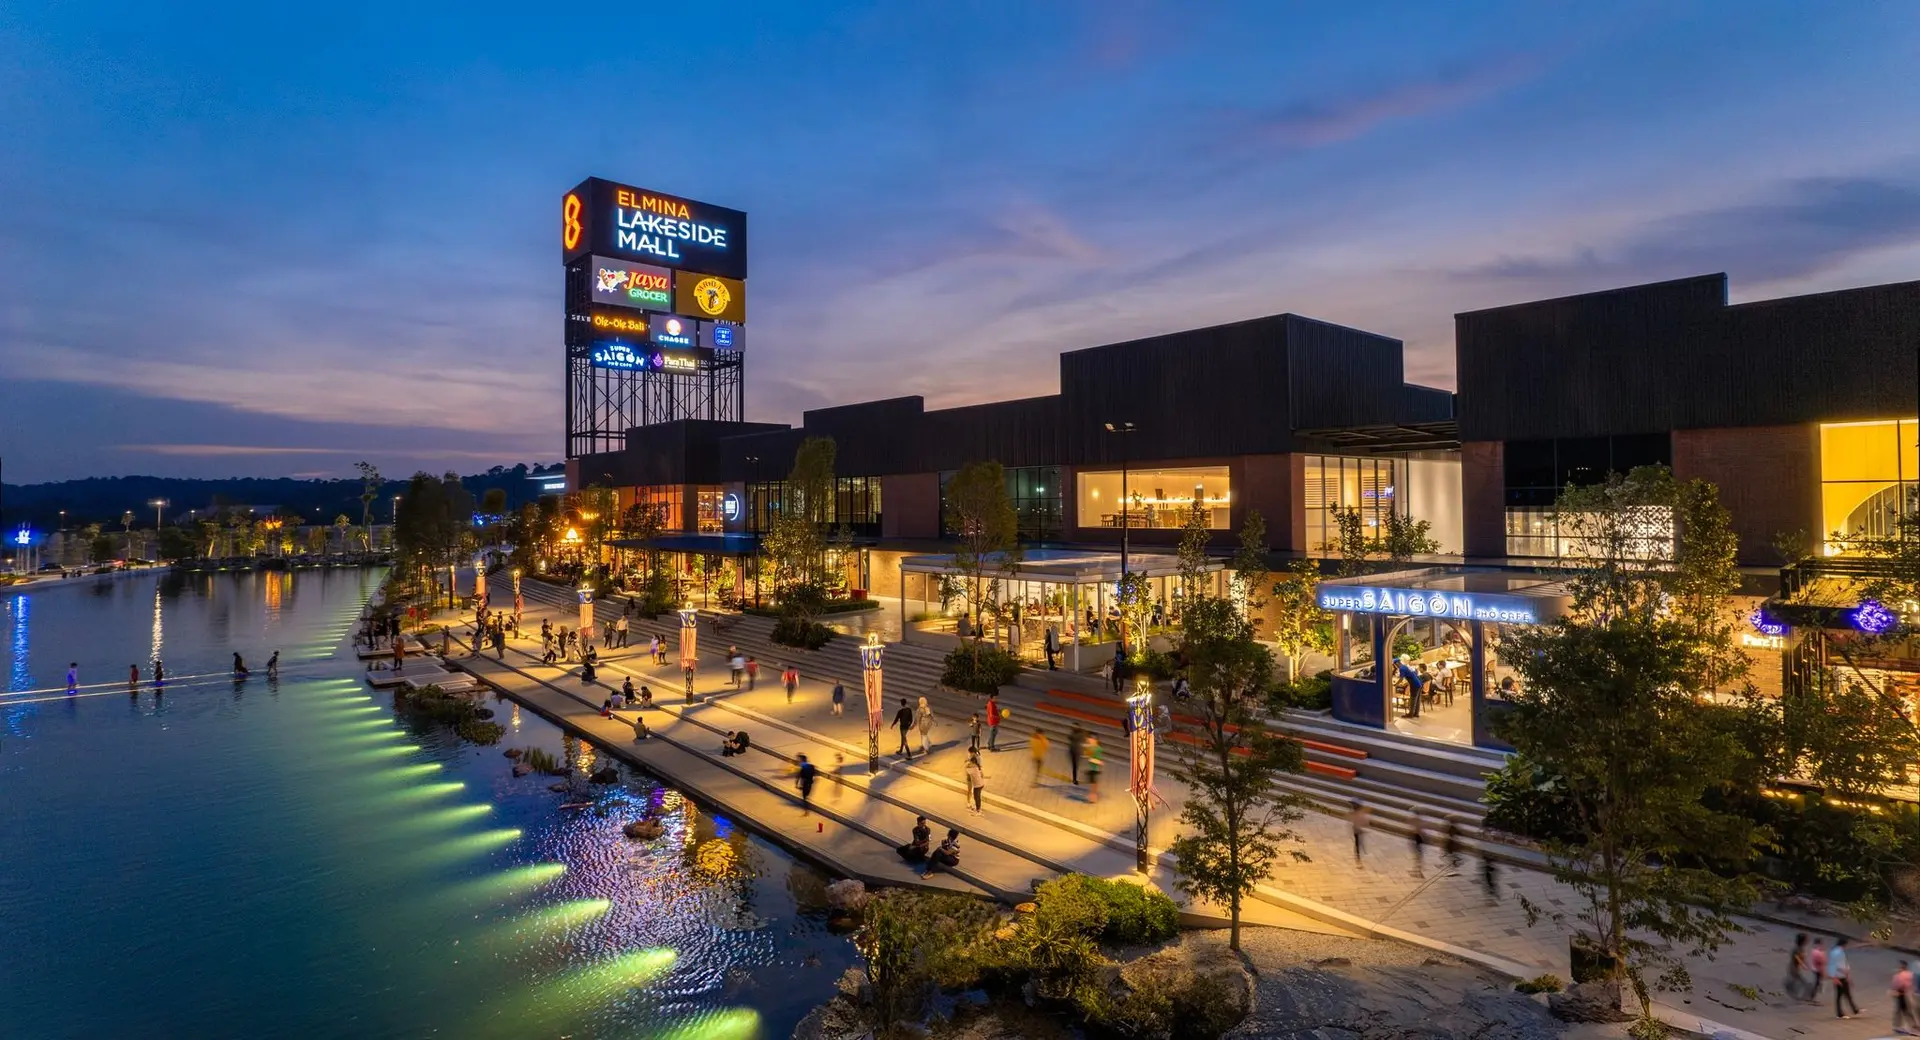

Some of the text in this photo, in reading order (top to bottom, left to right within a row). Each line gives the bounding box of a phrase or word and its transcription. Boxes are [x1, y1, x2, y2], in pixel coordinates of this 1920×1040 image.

[617, 189, 690, 220] ELMINA
[617, 208, 728, 248] LAKESIDE
[618, 229, 680, 259] MALL
[624, 271, 668, 290] Jaya
[629, 288, 668, 303] GROCER
[1322, 596, 1360, 609] SUPER
[1500, 610, 1530, 622] CAFE
